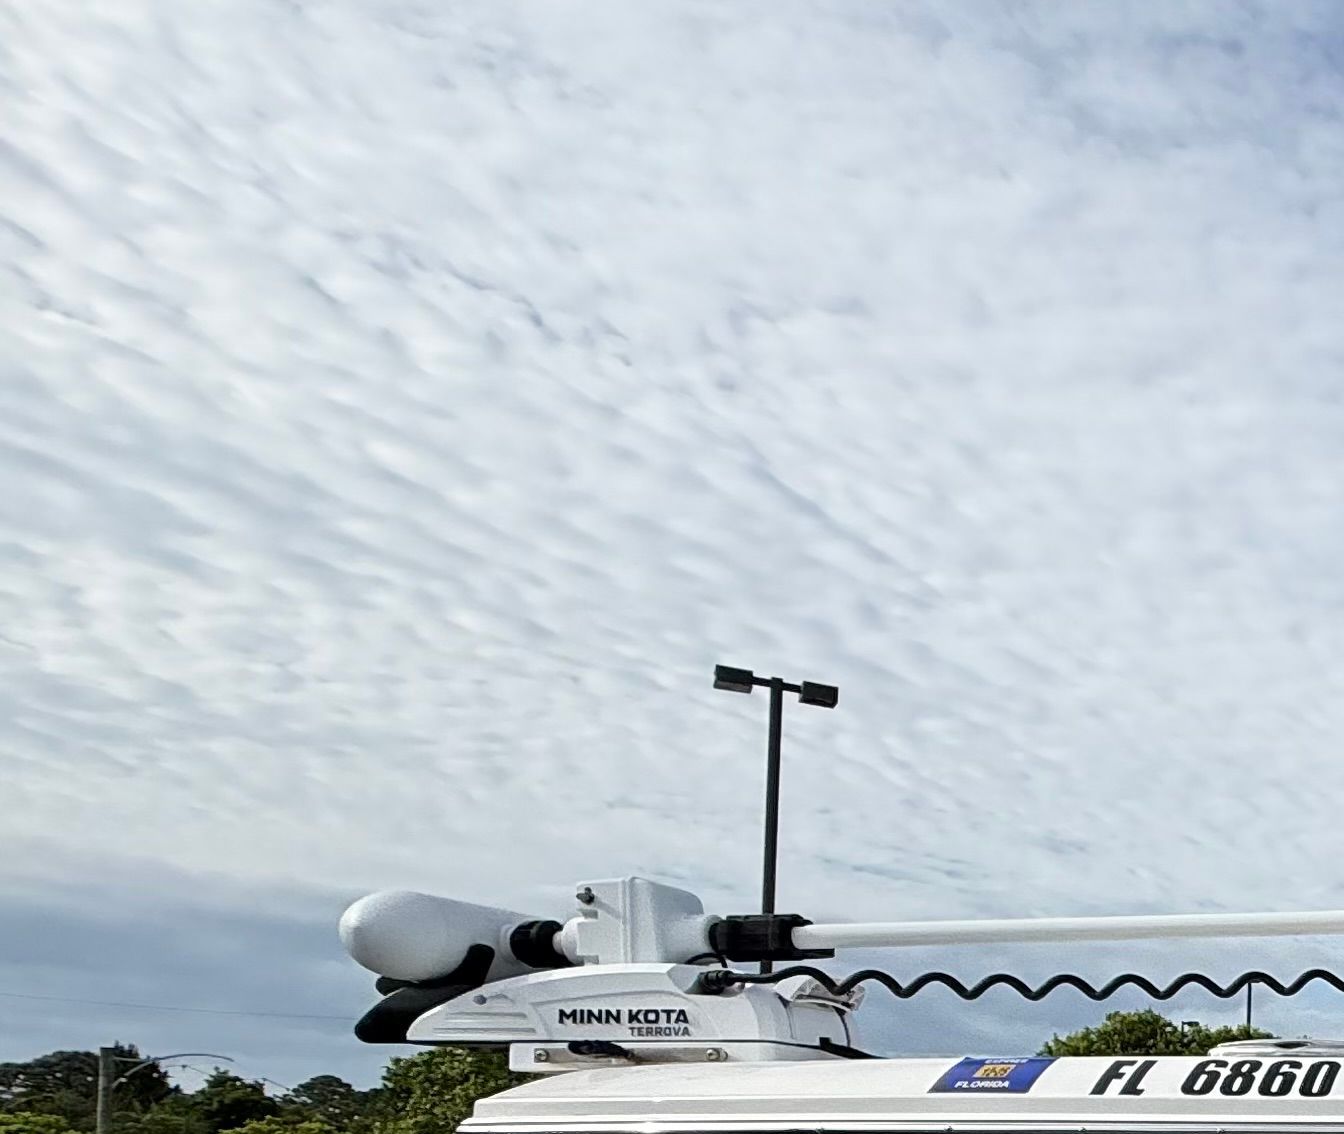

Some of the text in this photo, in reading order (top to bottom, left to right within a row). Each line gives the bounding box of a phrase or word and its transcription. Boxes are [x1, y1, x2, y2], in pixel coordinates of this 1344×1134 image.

[558, 1008, 690, 1025] MINN KOTA
[628, 1026, 691, 1037] TERROVA
[954, 1080, 1010, 1089] FLORIDA
[1088, 1059, 1158, 1096] FL
[1180, 1059, 1342, 1097] 6860
